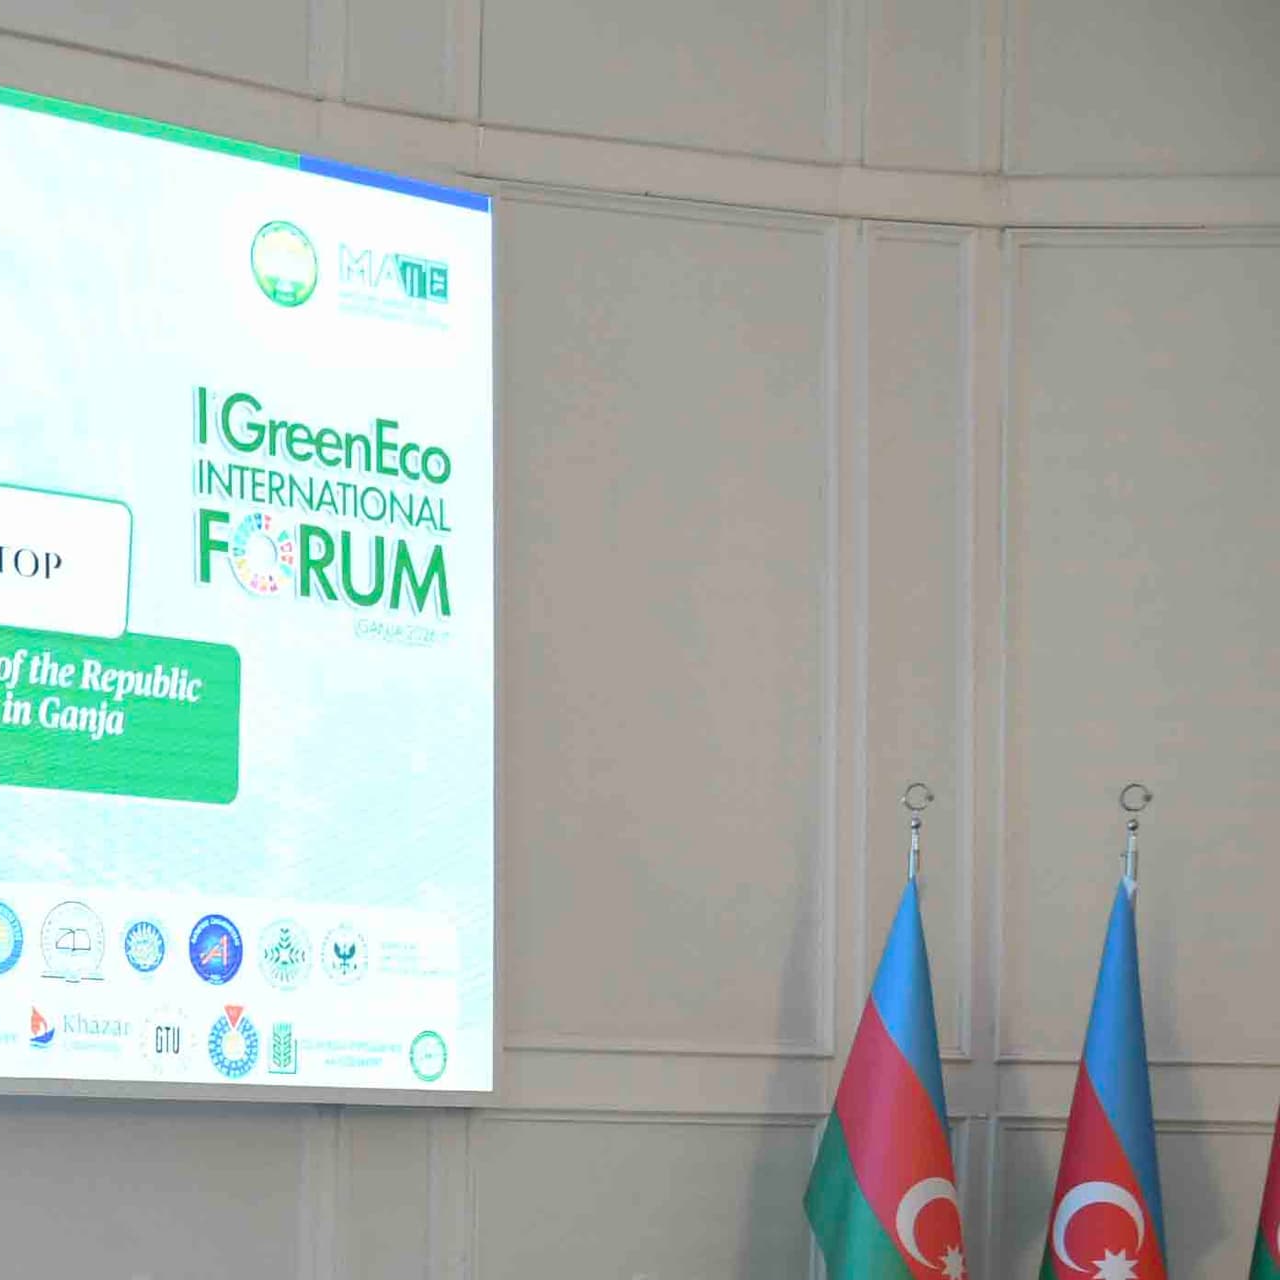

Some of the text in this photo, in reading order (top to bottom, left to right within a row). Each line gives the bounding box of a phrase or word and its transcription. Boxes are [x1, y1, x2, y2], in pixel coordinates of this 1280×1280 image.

[220, 392, 452, 484] GreenEco
[198, 459, 452, 532] INTERNATIONAL
[199, 508, 451, 617] FORUM
[30, 647, 73, 687] the
[81, 657, 203, 703] Republic
[2, 696, 32, 726] in
[38, 698, 125, 740] Ganja
[63, 1013, 131, 1037] Khazar
[155, 1025, 180, 1055] GTU
